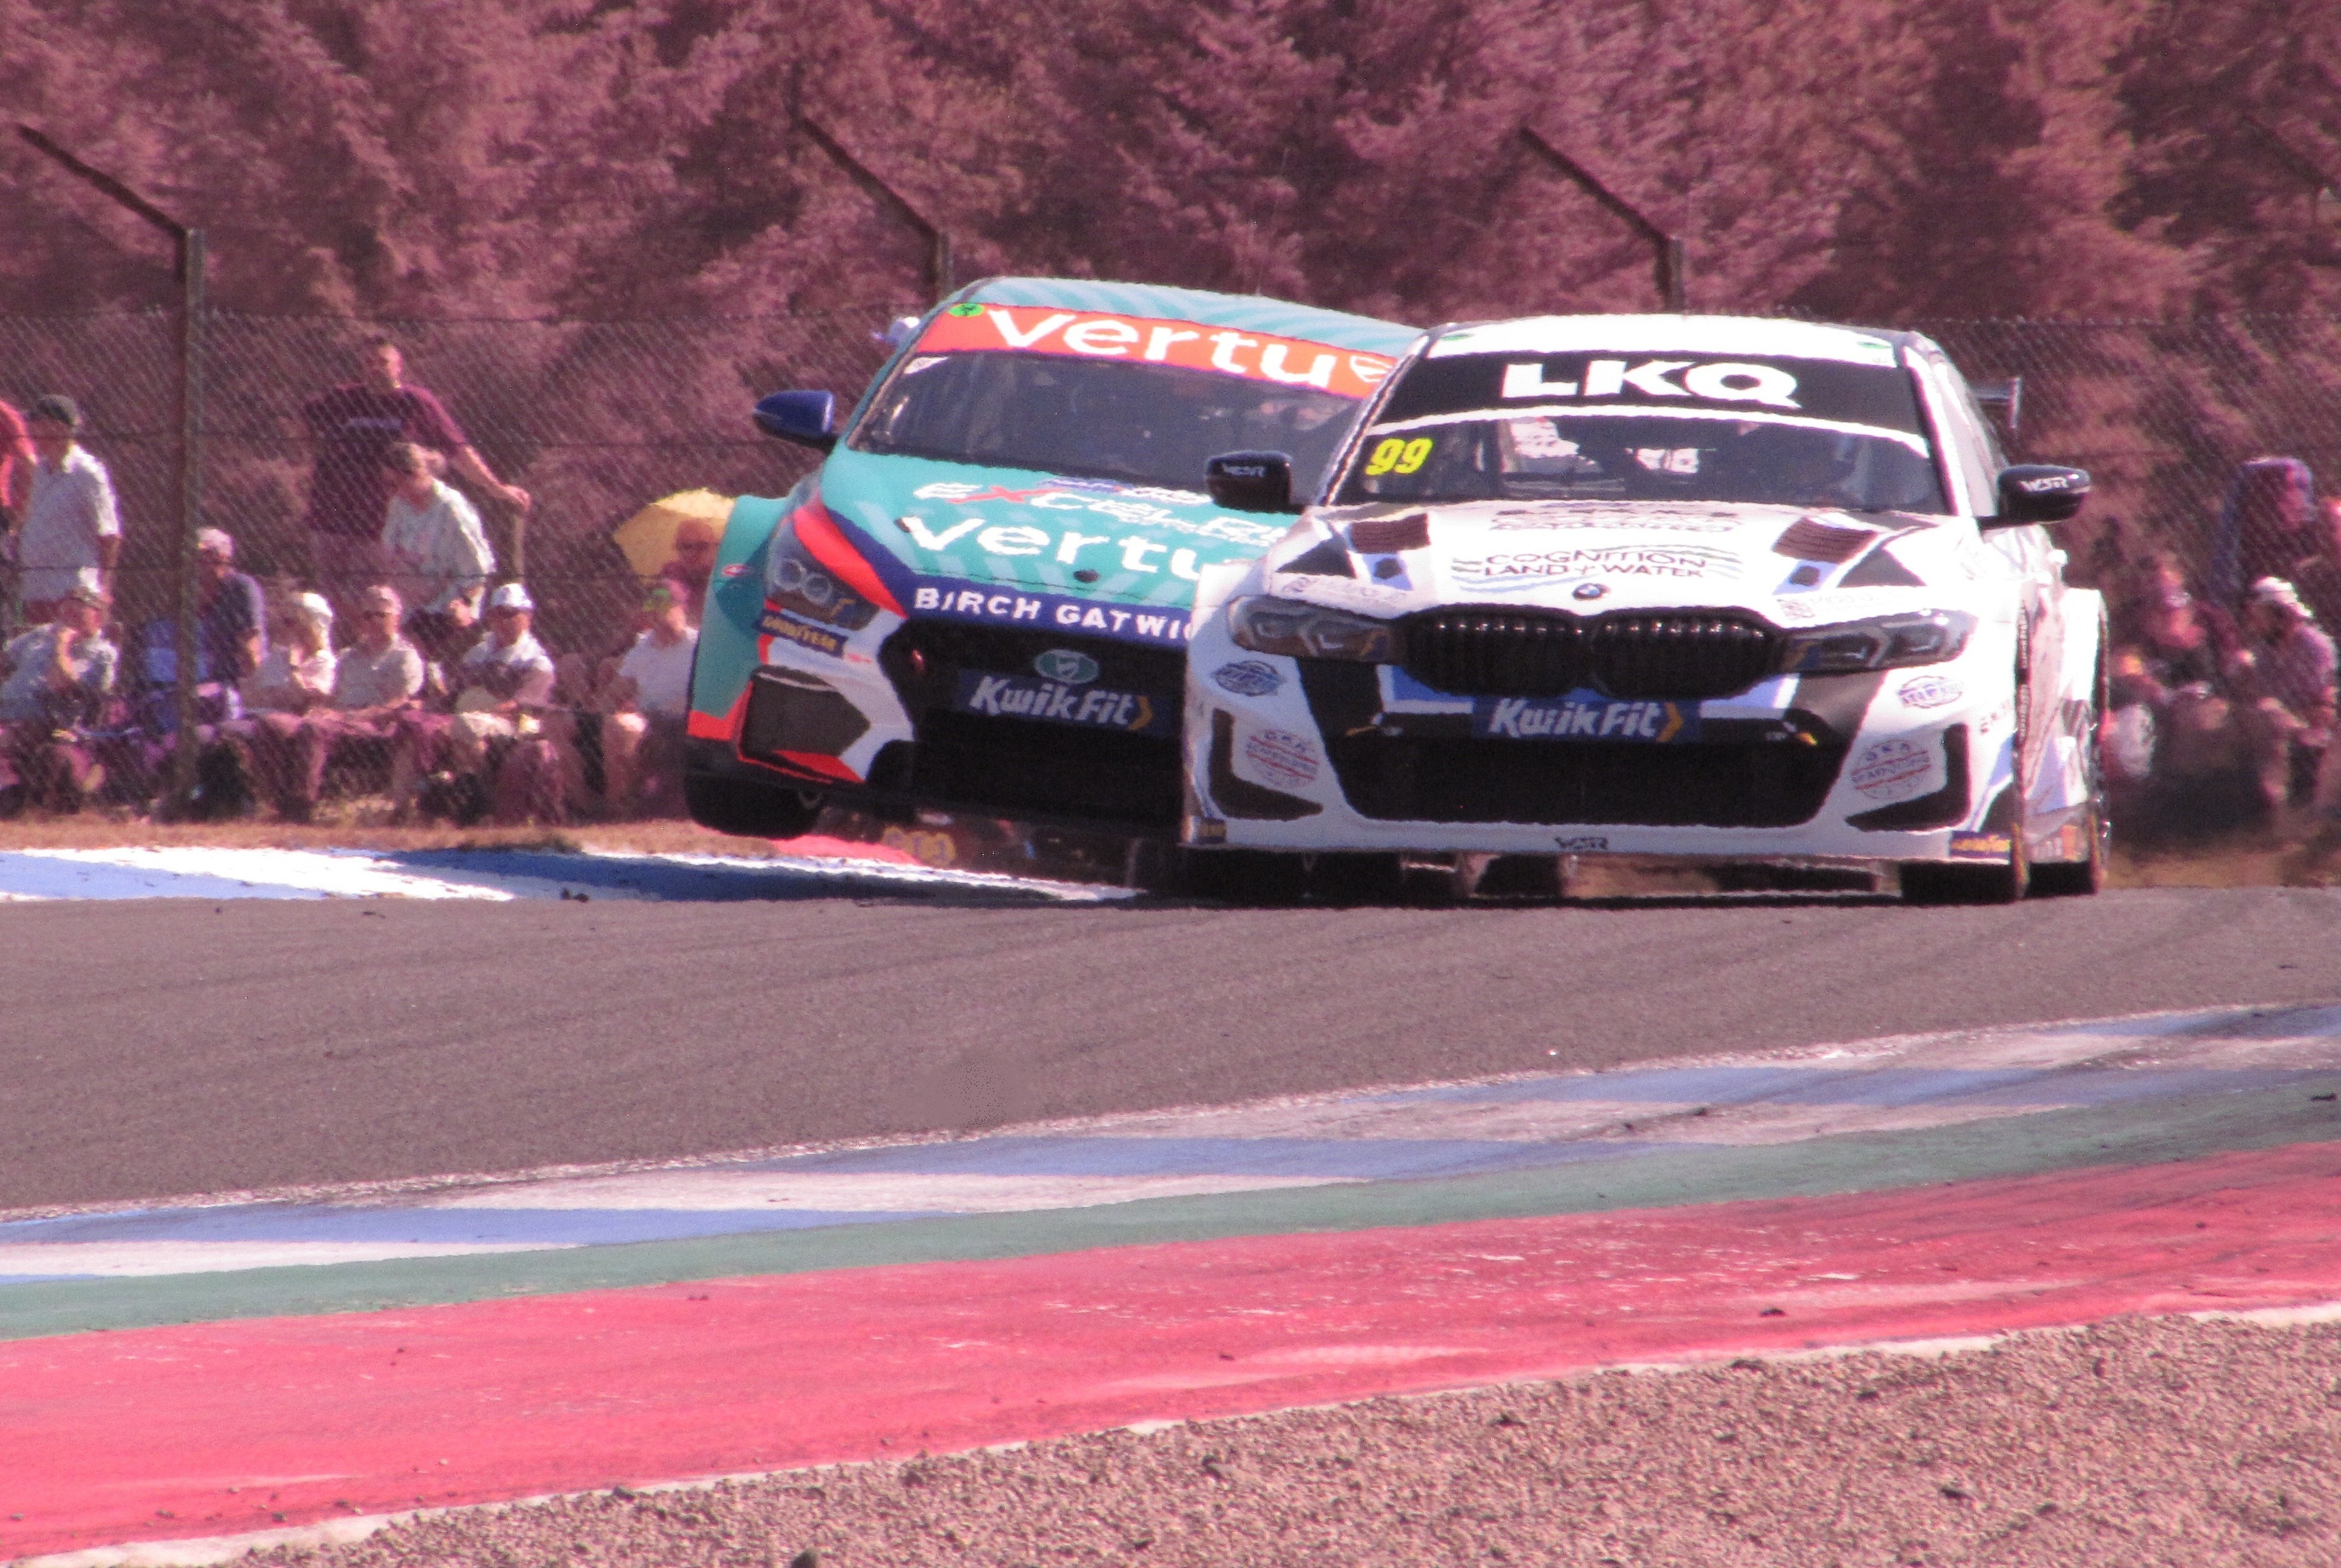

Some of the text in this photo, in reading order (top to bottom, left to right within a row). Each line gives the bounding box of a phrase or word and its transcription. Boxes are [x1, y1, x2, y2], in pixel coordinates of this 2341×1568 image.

[1501, 359, 1803, 409] LKQ
[1365, 437, 1433, 476] 99
[1485, 550, 1707, 569] COGNITION
[1485, 564, 1569, 576] LAND
[1602, 564, 1704, 578] WATER
[915, 586, 1041, 621] BIRCH
